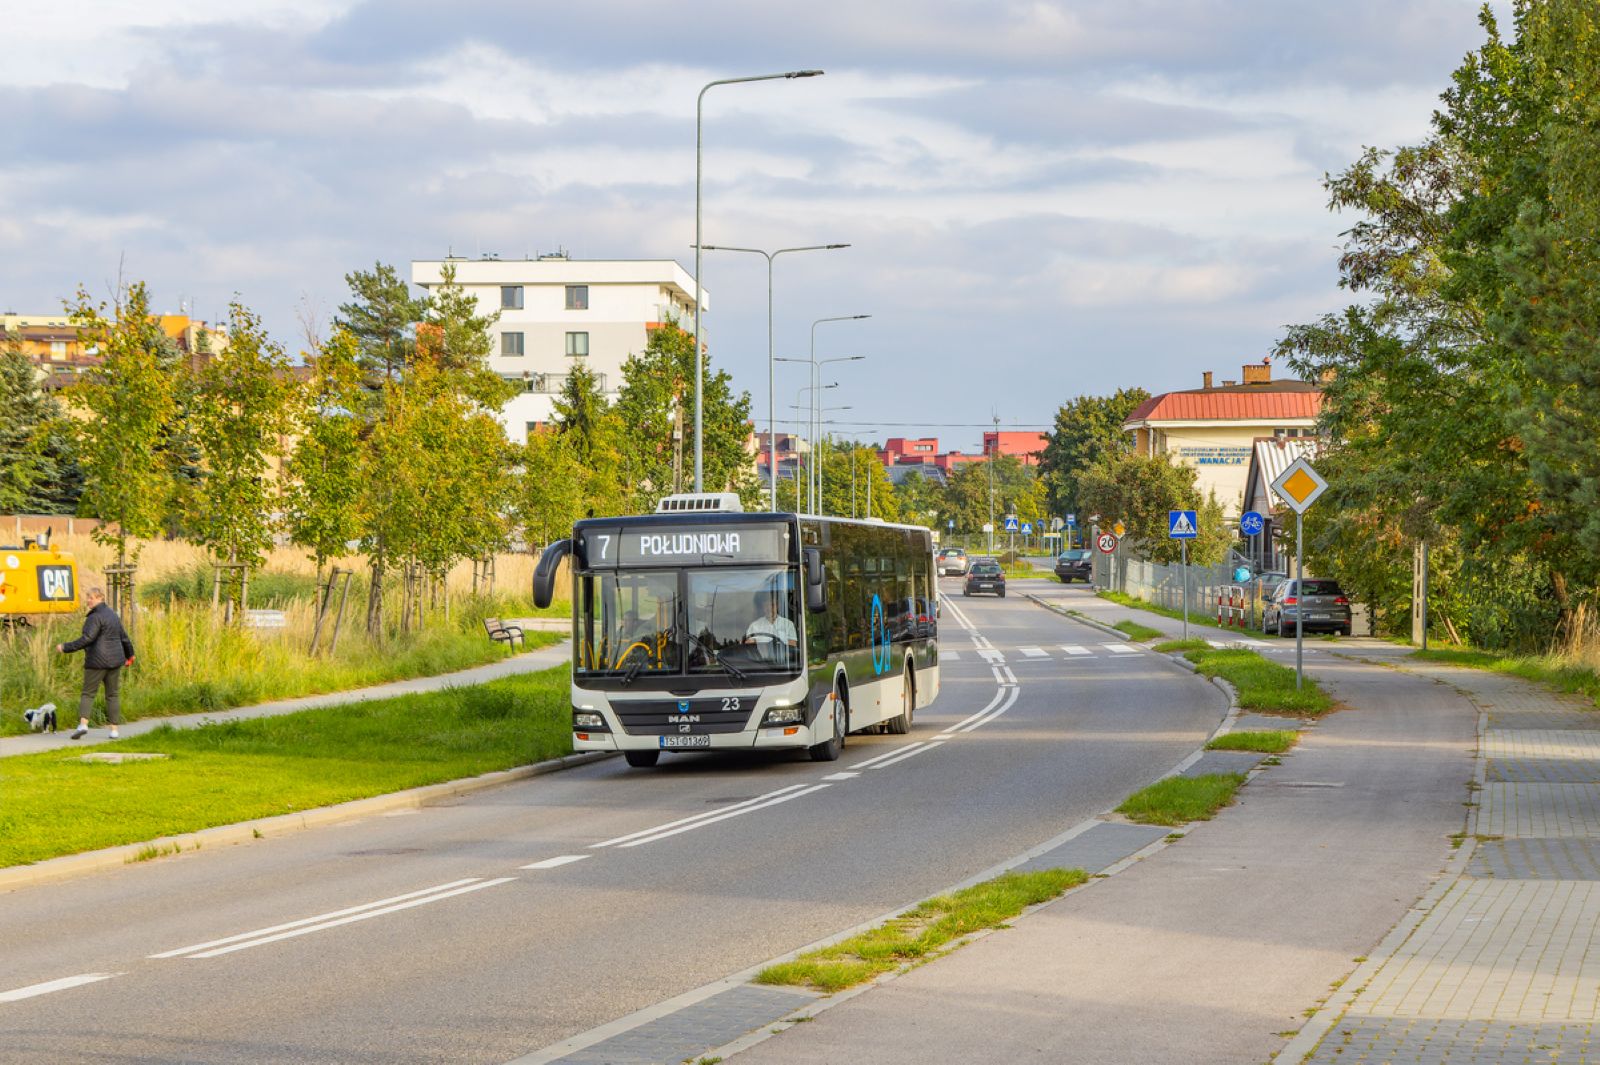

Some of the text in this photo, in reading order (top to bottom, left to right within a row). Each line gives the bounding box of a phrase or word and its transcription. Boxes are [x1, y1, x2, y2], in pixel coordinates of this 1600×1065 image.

[597, 533, 741, 559] 7 POŁUDNIOWA
[1100, 537, 1114, 548] 20
[43, 569, 70, 598] CAT
[721, 697, 741, 711] 23
[668, 715, 700, 723] MAN
